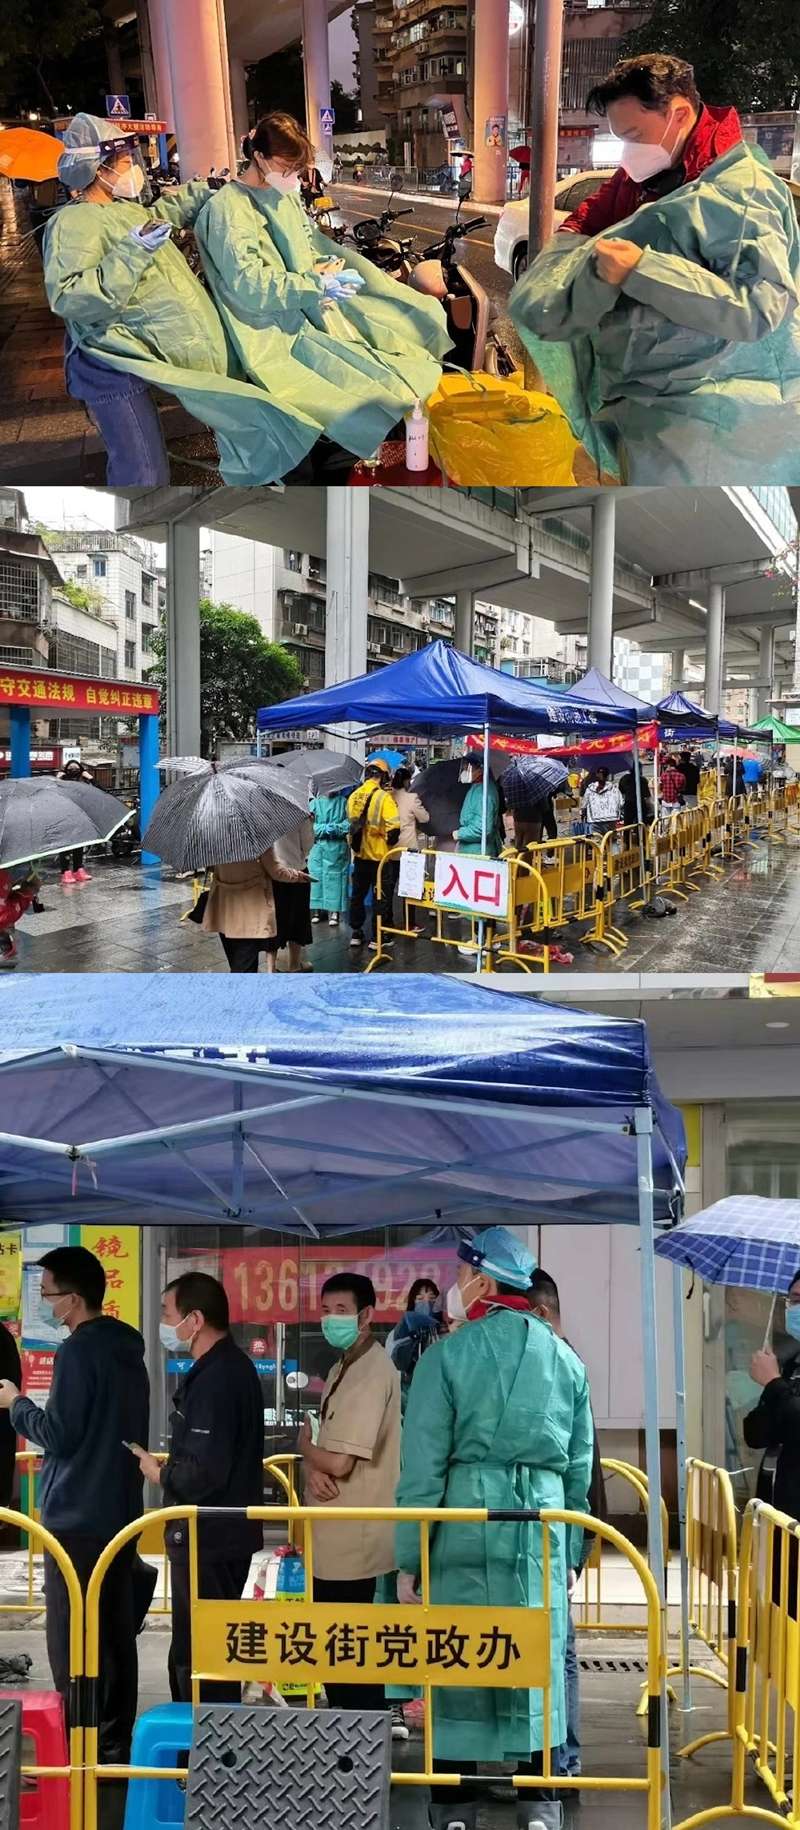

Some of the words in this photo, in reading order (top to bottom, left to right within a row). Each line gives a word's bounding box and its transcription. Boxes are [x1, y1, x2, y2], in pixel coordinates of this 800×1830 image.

[442, 863, 500, 906] 入口
[225, 1621, 520, 1669] 建设街党政办
